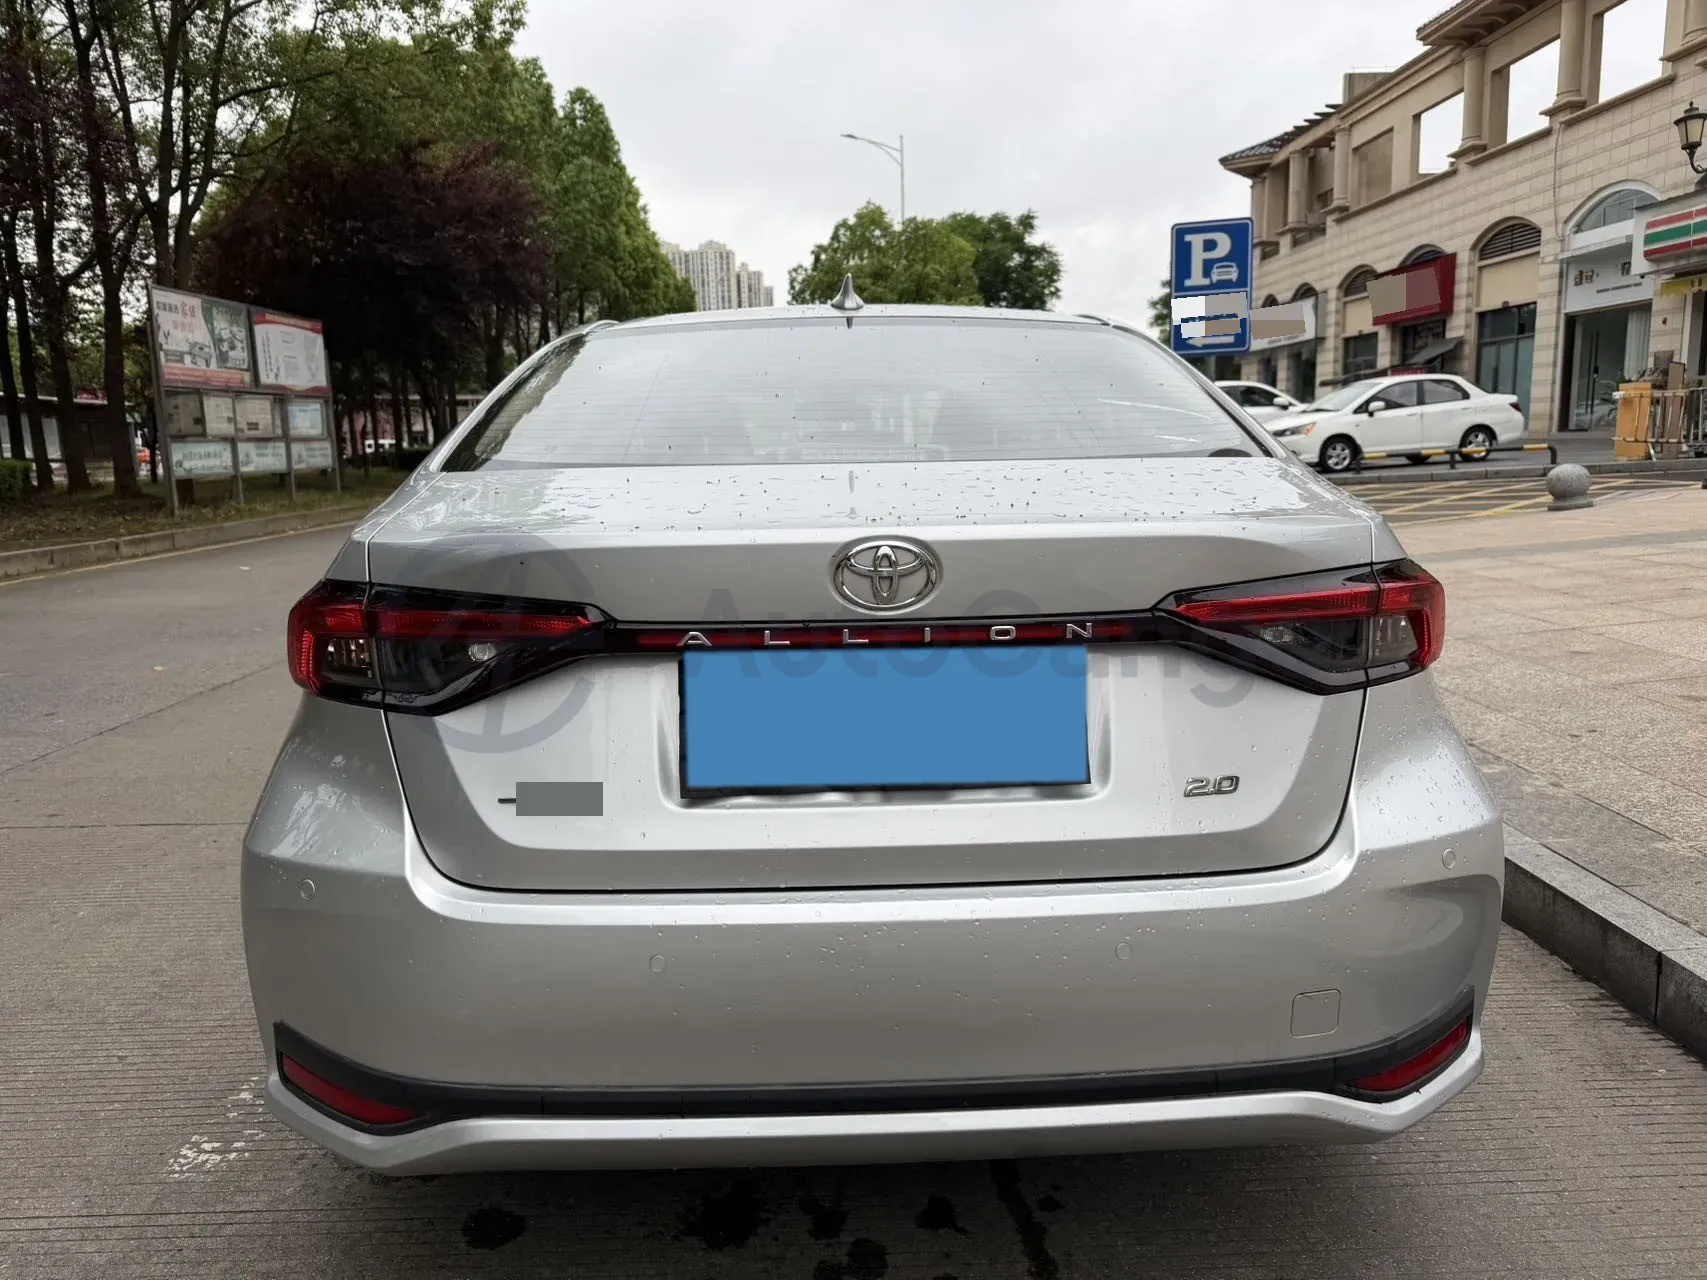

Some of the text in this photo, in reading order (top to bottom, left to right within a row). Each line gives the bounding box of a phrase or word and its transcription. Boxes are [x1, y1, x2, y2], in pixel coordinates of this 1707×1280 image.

[1184, 232, 1232, 287] P
[676, 622, 1093, 647] ALLION
[1183, 775, 1240, 798] 2.0
